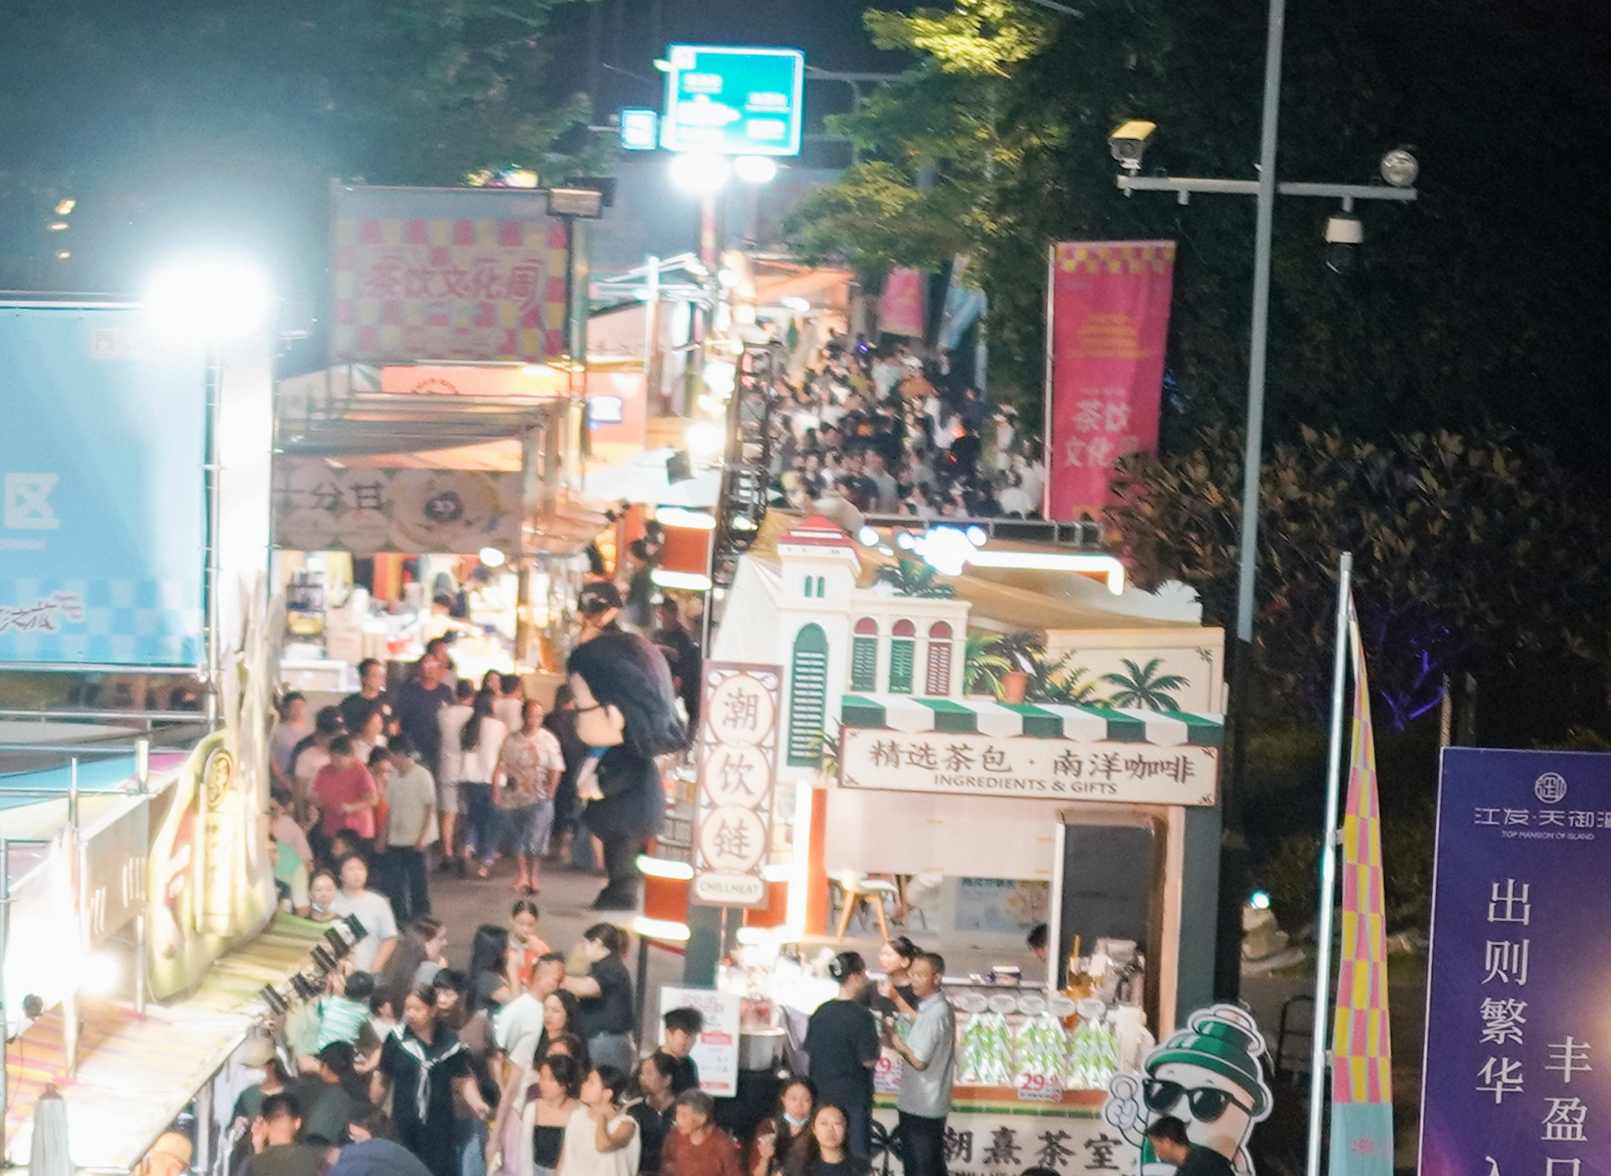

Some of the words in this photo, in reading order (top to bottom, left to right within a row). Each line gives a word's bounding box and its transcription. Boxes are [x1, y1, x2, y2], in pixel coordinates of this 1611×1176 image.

[934, 774, 1046, 791] INGREDIENTS
[1052, 780, 1065, 792] &
[1071, 781, 1117, 795] GIFTS
[1475, 878, 1530, 1104] 出则繁华
